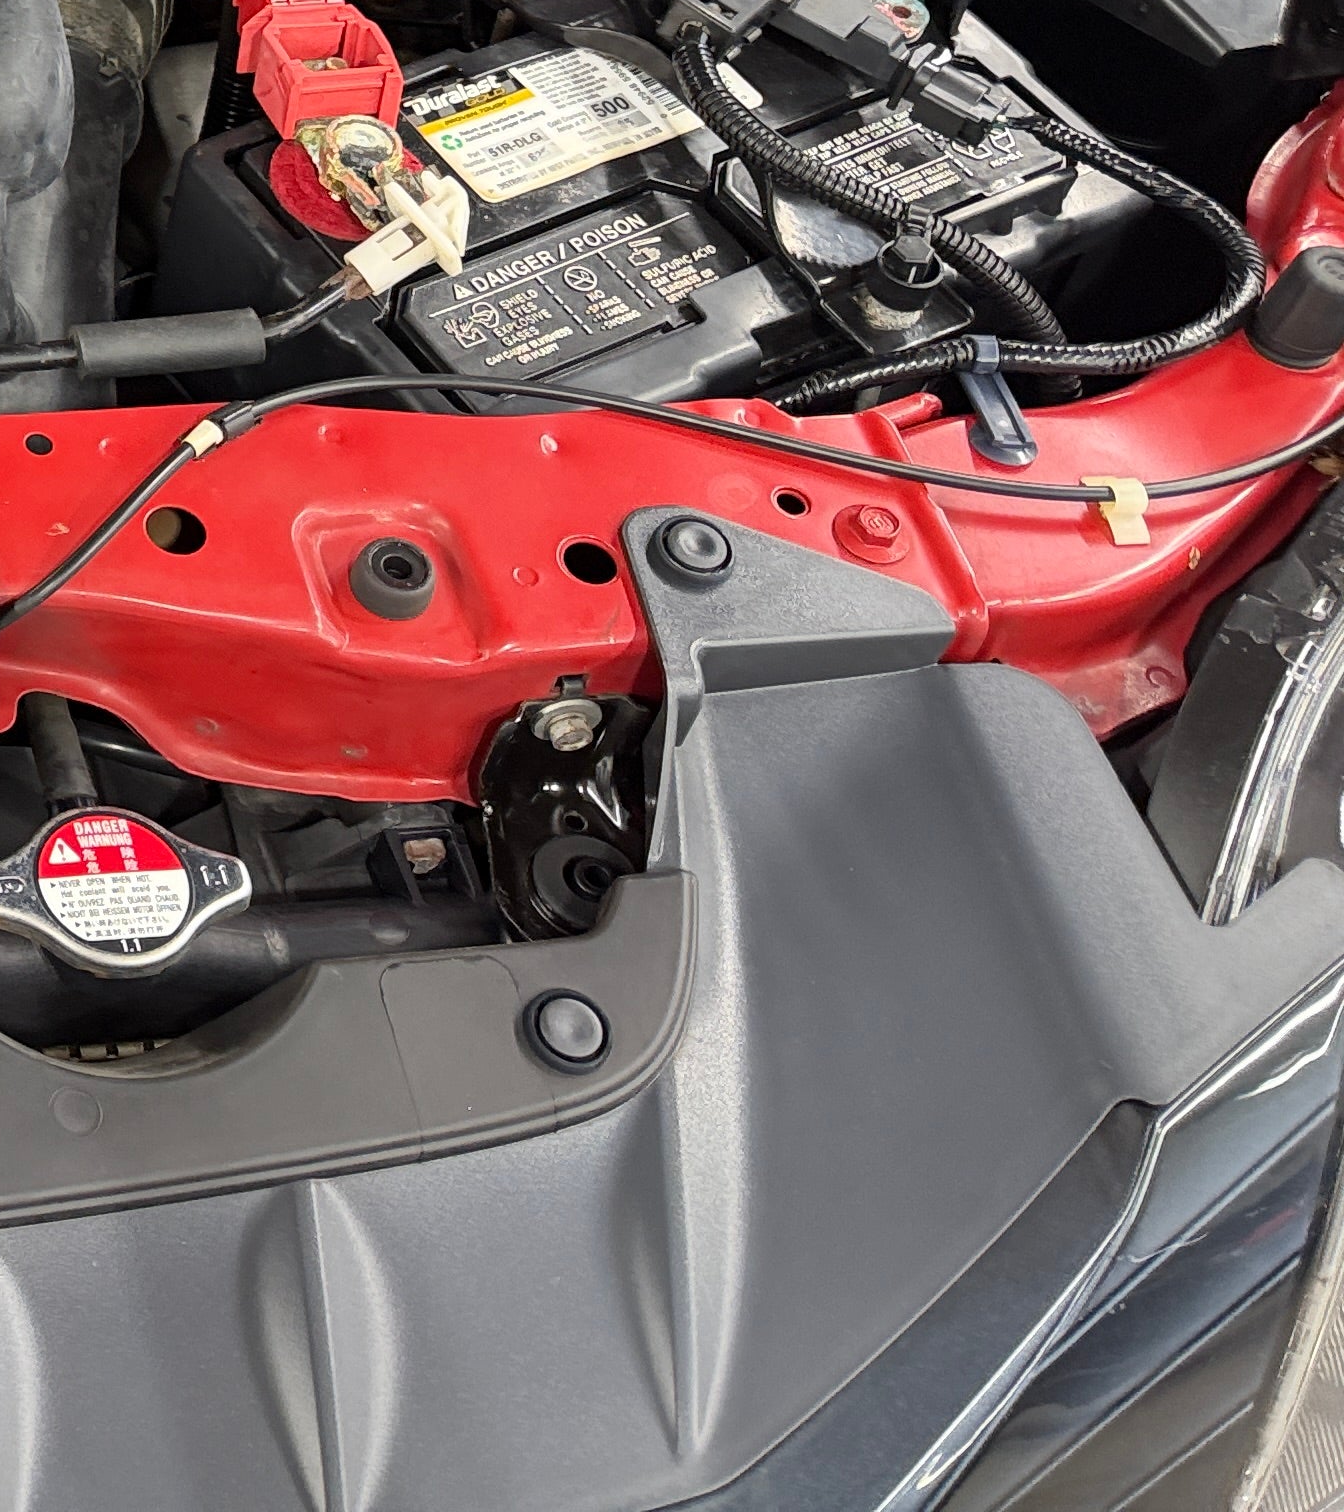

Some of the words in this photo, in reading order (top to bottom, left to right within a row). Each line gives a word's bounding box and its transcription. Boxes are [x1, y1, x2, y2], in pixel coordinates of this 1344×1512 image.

[402, 75, 502, 116] Duralast
[465, 87, 506, 107] GOLD
[591, 96, 630, 118] 500
[488, 132, 543, 157] 51R-DLG
[853, 136, 912, 166] IMMEDIATELY
[868, 156, 888, 170] GET
[880, 162, 905, 177] FAST
[470, 249, 557, 292] DANGER
[558, 242, 567, 260] /
[569, 212, 649, 254] POISON
[641, 254, 693, 280] SULFURIC
[692, 244, 717, 261] ACID
[650, 275, 671, 288] CAN
[669, 265, 697, 280] CAUSE
[498, 289, 539, 310] SHIELD
[585, 289, 606, 302] NO
[507, 301, 538, 319] EYES
[493, 308, 552, 338] EXPLOSIVE
[501, 326, 540, 346] GASES
[73, 818, 129, 835] DANGER
[76, 832, 133, 848] WARNUNG
[58, 879, 81, 888] NEVER
[86, 877, 106, 887] OPEN
[110, 875, 131, 884] WHEN
[199, 864, 230, 887] 1.1
[61, 890, 73, 898] Hot
[110, 896, 124, 905] PAS
[127, 895, 151, 904] QUAND
[67, 909, 86, 918] NICHT
[103, 906, 130, 916] HEISSEN
[120, 938, 142, 953] 1.1
